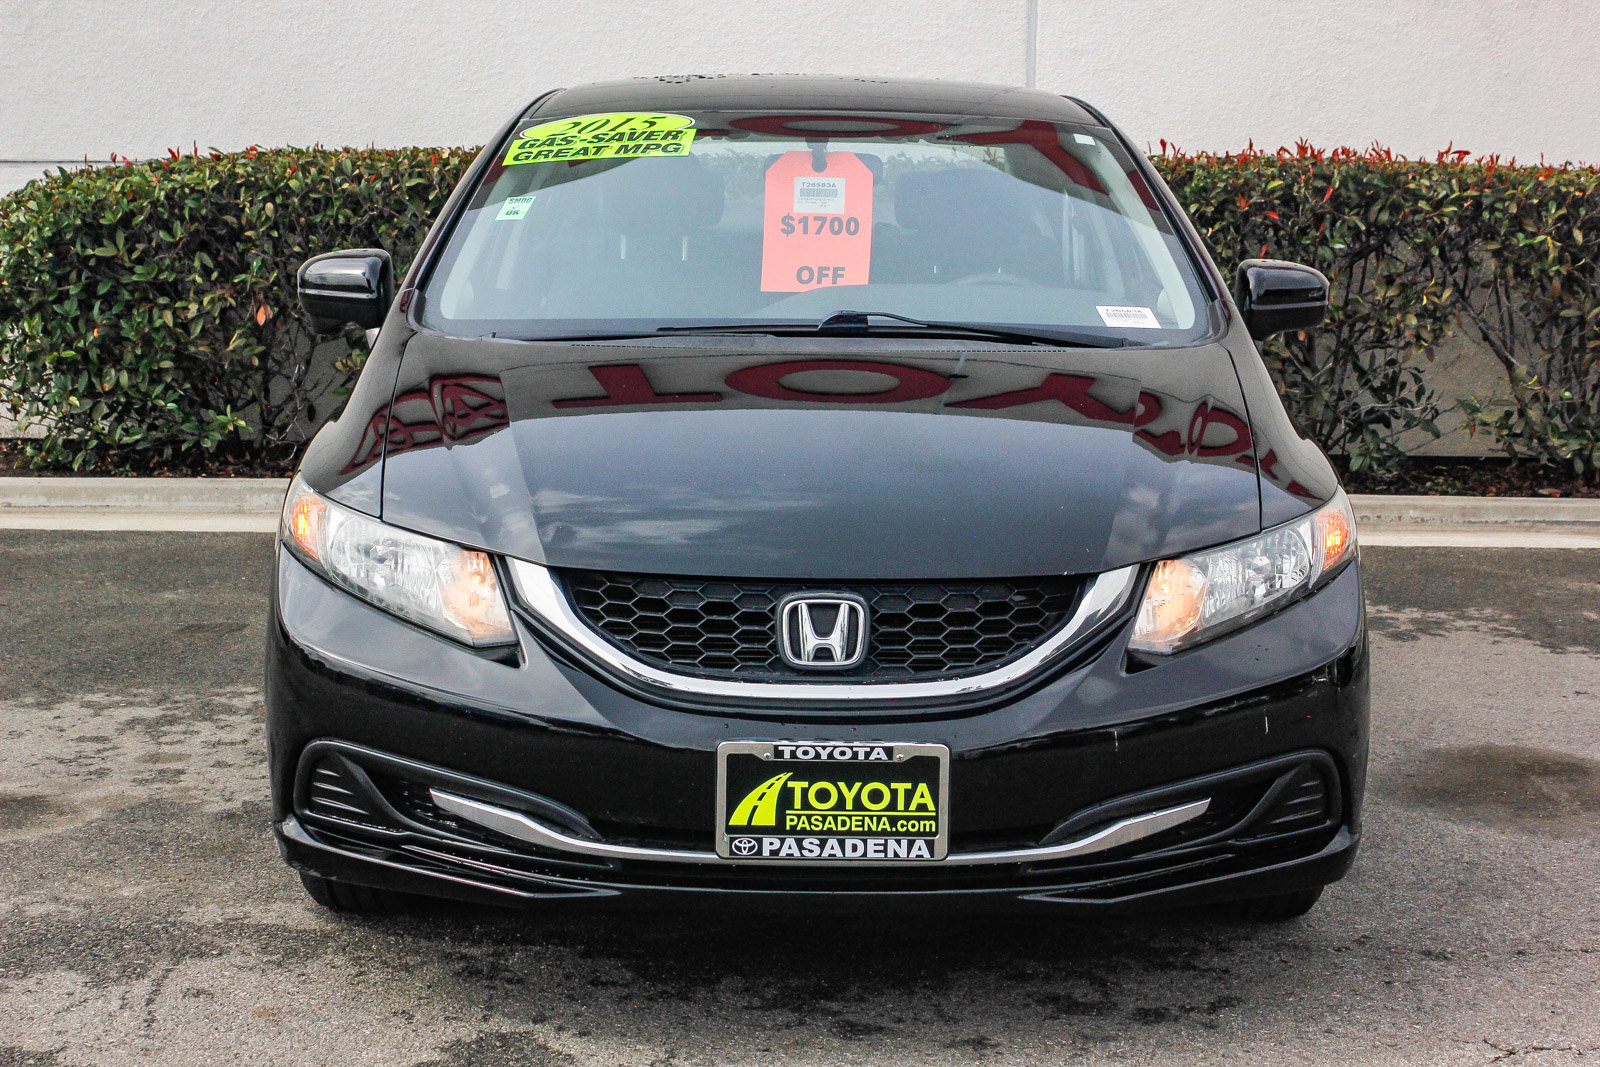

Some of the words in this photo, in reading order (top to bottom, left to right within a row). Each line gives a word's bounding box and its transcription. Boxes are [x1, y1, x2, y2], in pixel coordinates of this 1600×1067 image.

[546, 116, 667, 137] 2015
[517, 130, 686, 150] GAS-SAVER
[512, 145, 613, 162] GREAT
[615, 142, 684, 155] MPG
[780, 212, 860, 237] $1700
[796, 265, 846, 285] OFF
[778, 746, 889, 761] TOYOTA
[787, 781, 936, 812] TOYOTA
[786, 815, 937, 833] PASADENA.com
[762, 838, 931, 859] PASADENA
